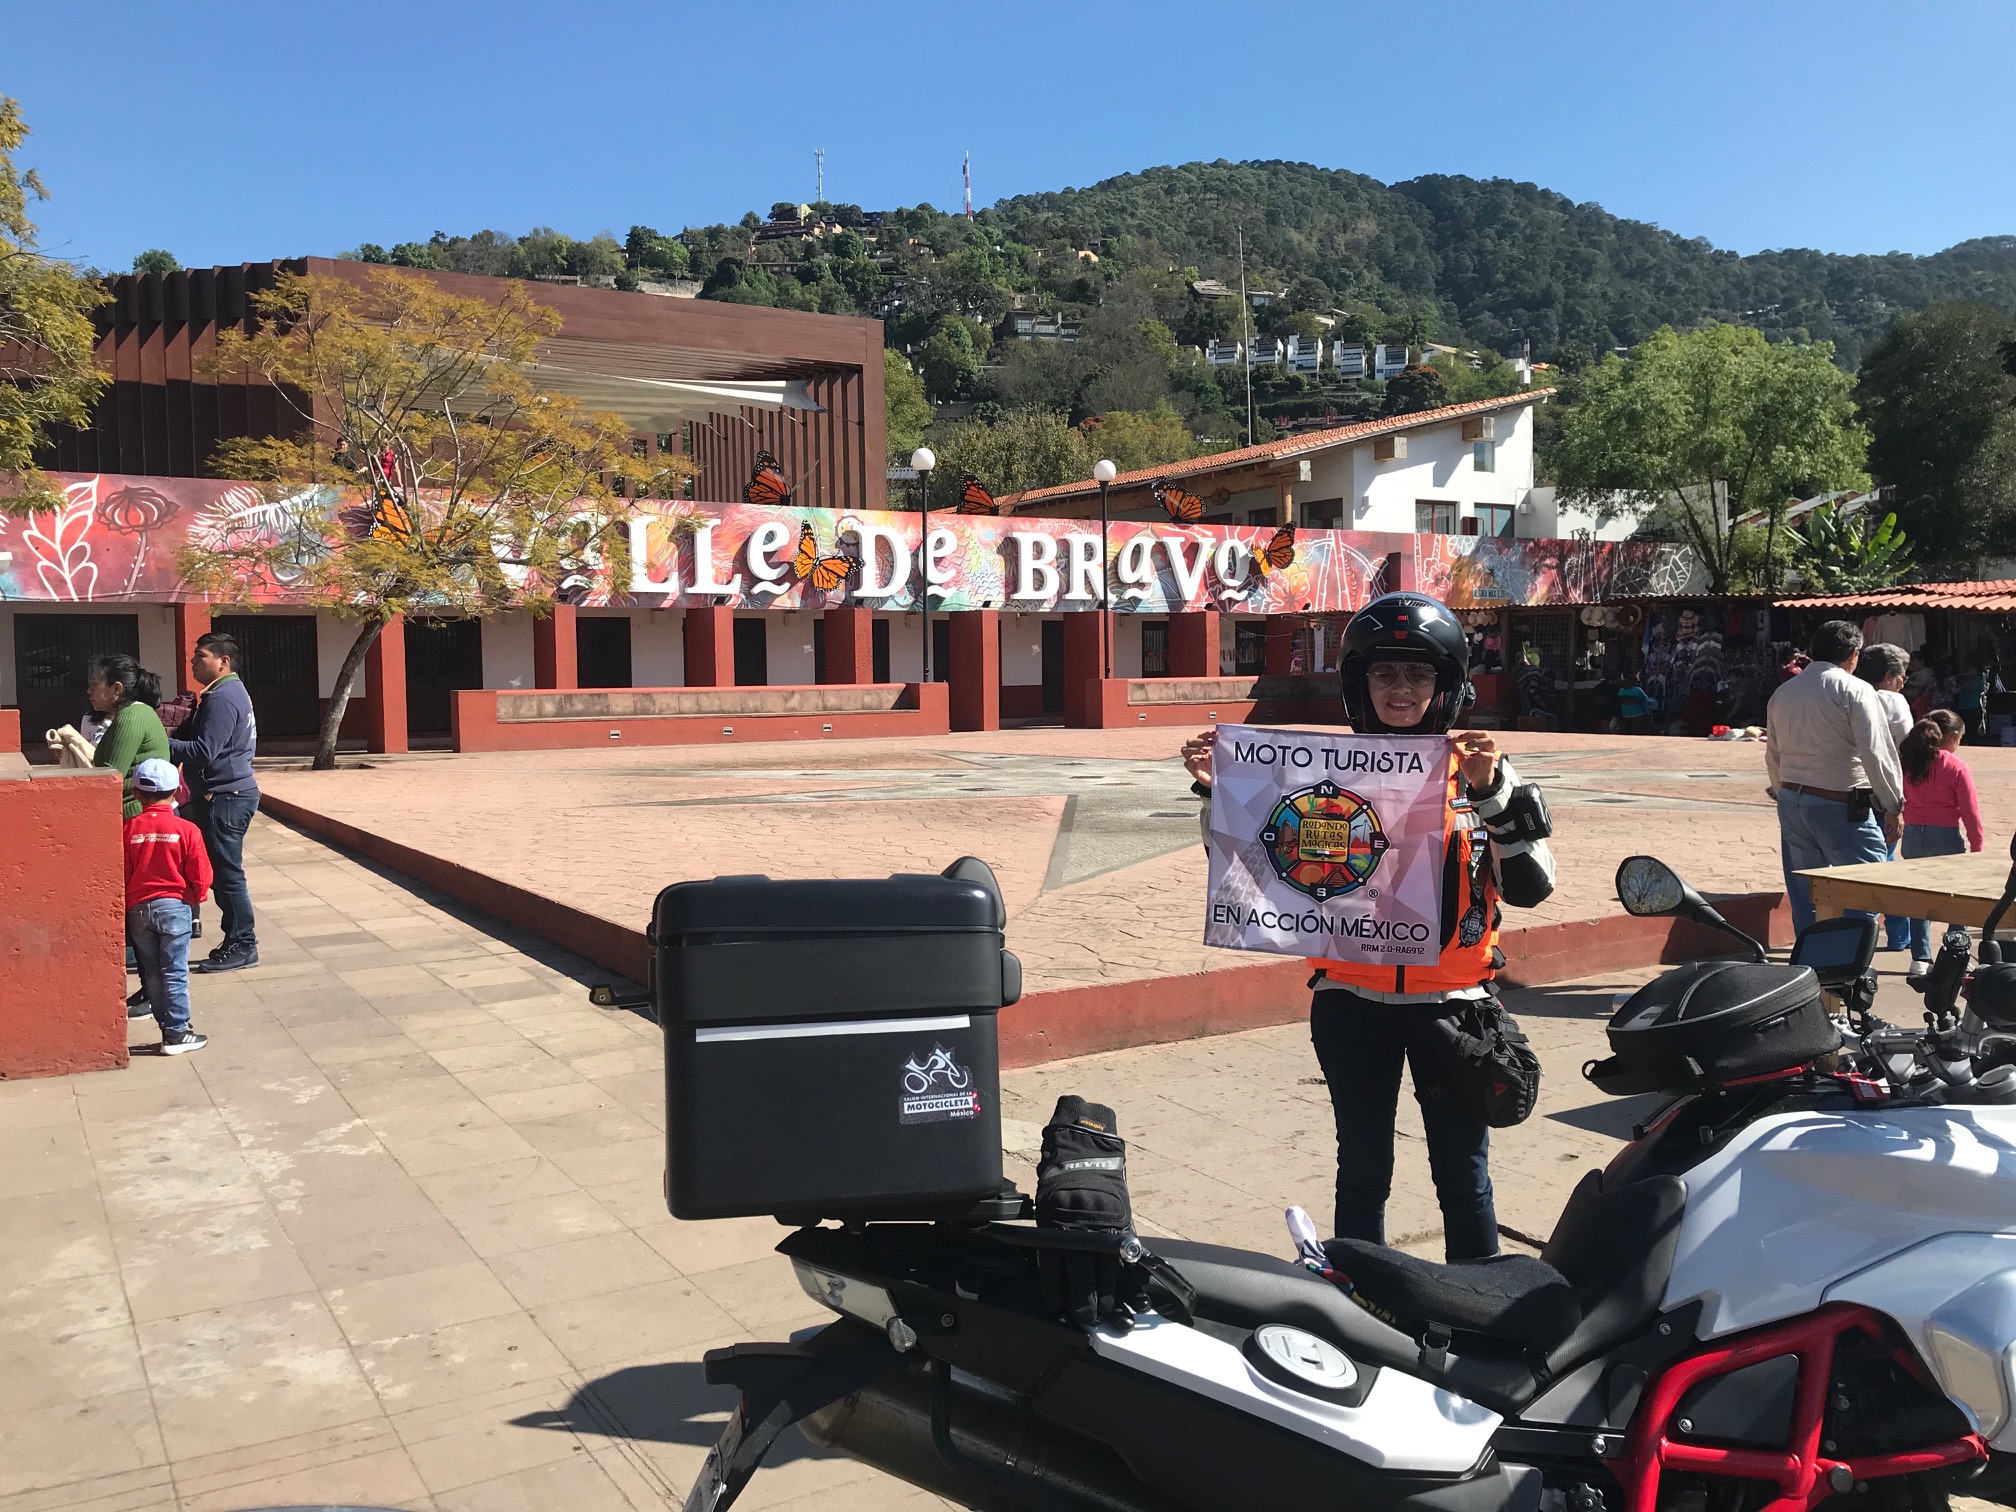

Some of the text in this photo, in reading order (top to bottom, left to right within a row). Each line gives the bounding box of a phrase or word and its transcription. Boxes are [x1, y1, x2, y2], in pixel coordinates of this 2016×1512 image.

[1234, 741, 1424, 774] MOTO TURISTA
[1320, 785, 1333, 795] N
[1263, 832, 1275, 841] O
[1374, 839, 1385, 849] E
[1316, 887, 1327, 897] S
[1213, 905, 1241, 924] EN
[1246, 909, 1334, 935] ACCIÓN
[1341, 914, 1430, 942] MÉXICO
[1361, 943, 1425, 955] RRM 2.0-RA6912
[920, 1092, 959, 1100] INTERNACIONAL
[906, 1099, 970, 1112] MOTOCICLETA
